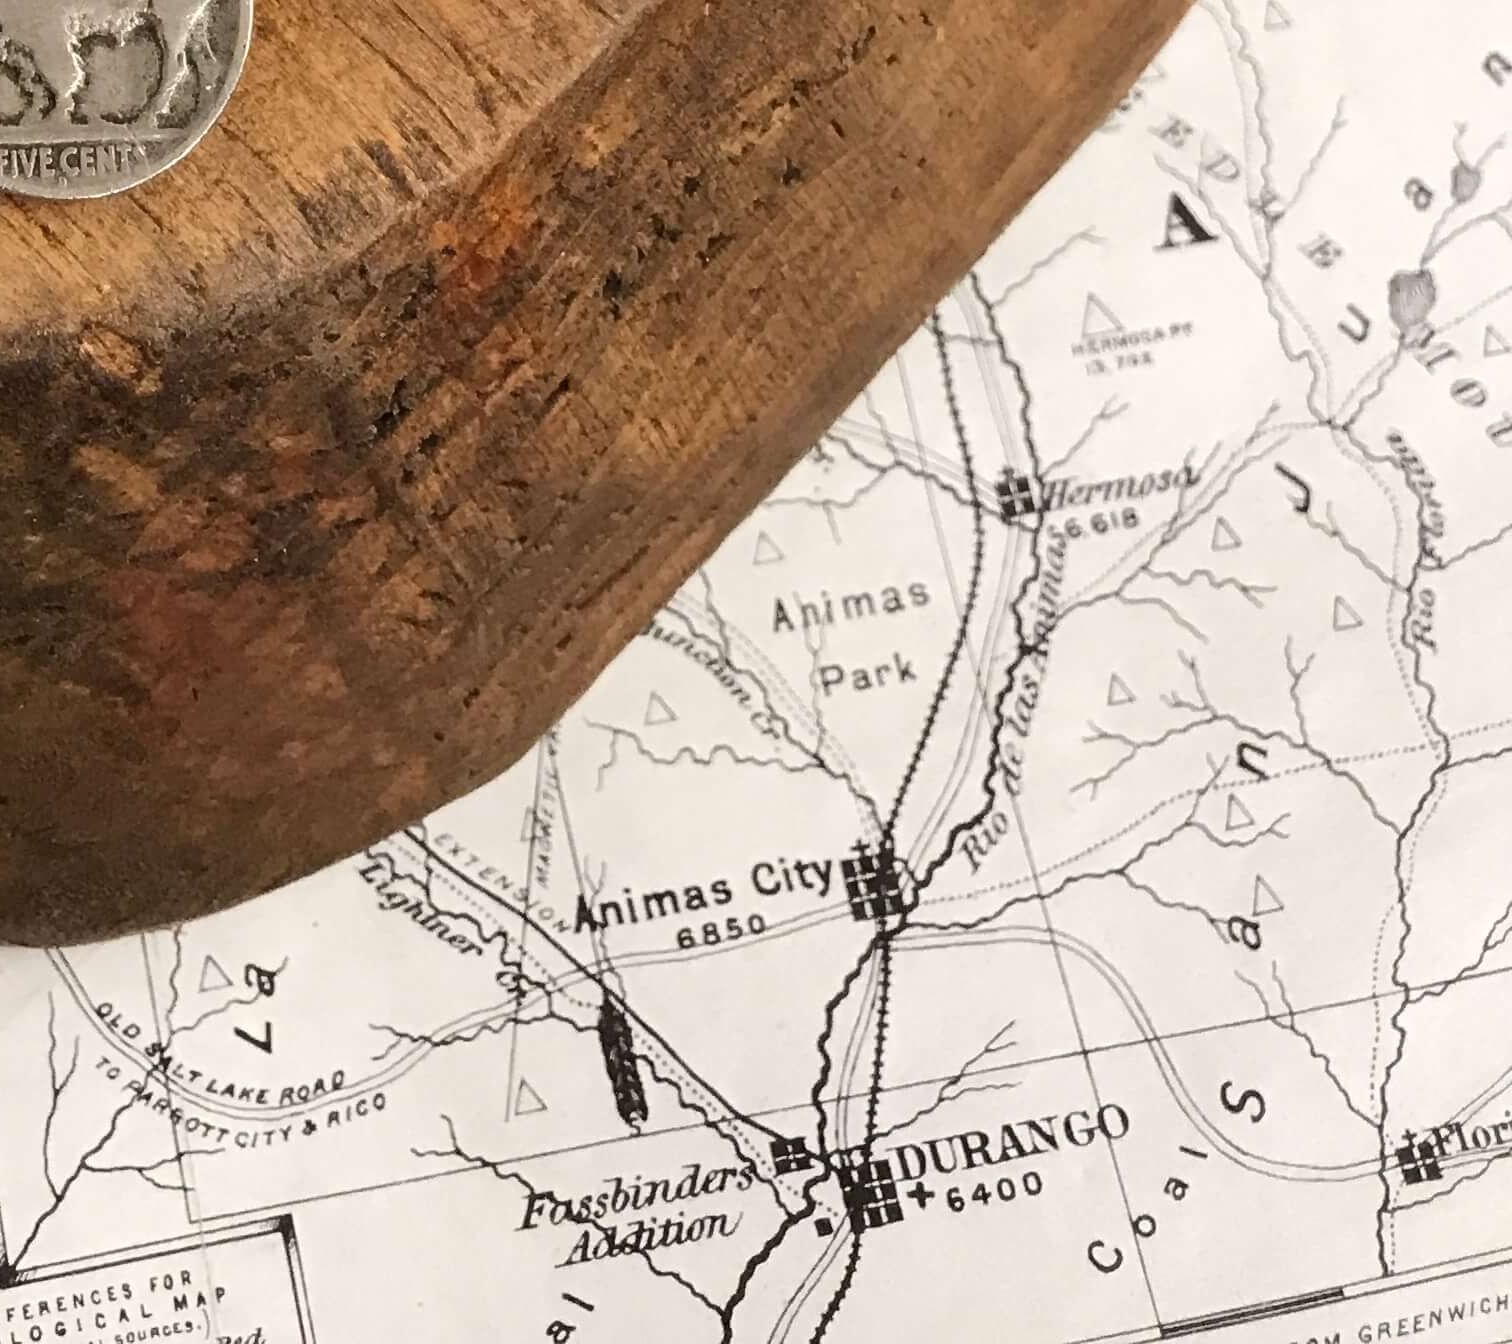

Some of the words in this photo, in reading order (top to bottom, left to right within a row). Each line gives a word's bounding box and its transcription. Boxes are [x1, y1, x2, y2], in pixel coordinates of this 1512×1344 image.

[1044, 464, 1201, 512] Hermosa
[771, 579, 931, 635] Animas
[1410, 587, 1440, 657] Rio
[819, 653, 919, 697] Park
[1005, 673, 1040, 738] las
[998, 740, 1025, 797] de
[960, 811, 1009, 875] Rio
[434, 832, 571, 934] EXTENSION
[574, 878, 734, 933] Animas
[751, 857, 835, 903] City
[676, 913, 768, 951] 6850
[96, 1002, 142, 1040] OLD
[206, 1078, 270, 1106] LAKE
[278, 1069, 346, 1106] ROAD
[95, 1057, 122, 1081] TO
[234, 1125, 293, 1149] CITY
[326, 1092, 388, 1129] RICO
[888, 1103, 1131, 1183] DURANGO
[515, 1163, 756, 1232] Fassbinders
[946, 1170, 1044, 1213] 6400
[554, 1209, 743, 1268] Addition
[150, 1269, 194, 1294] FOR
[173, 1286, 228, 1314] MAP
[1357, 1292, 1510, 1343] GREENWICH
